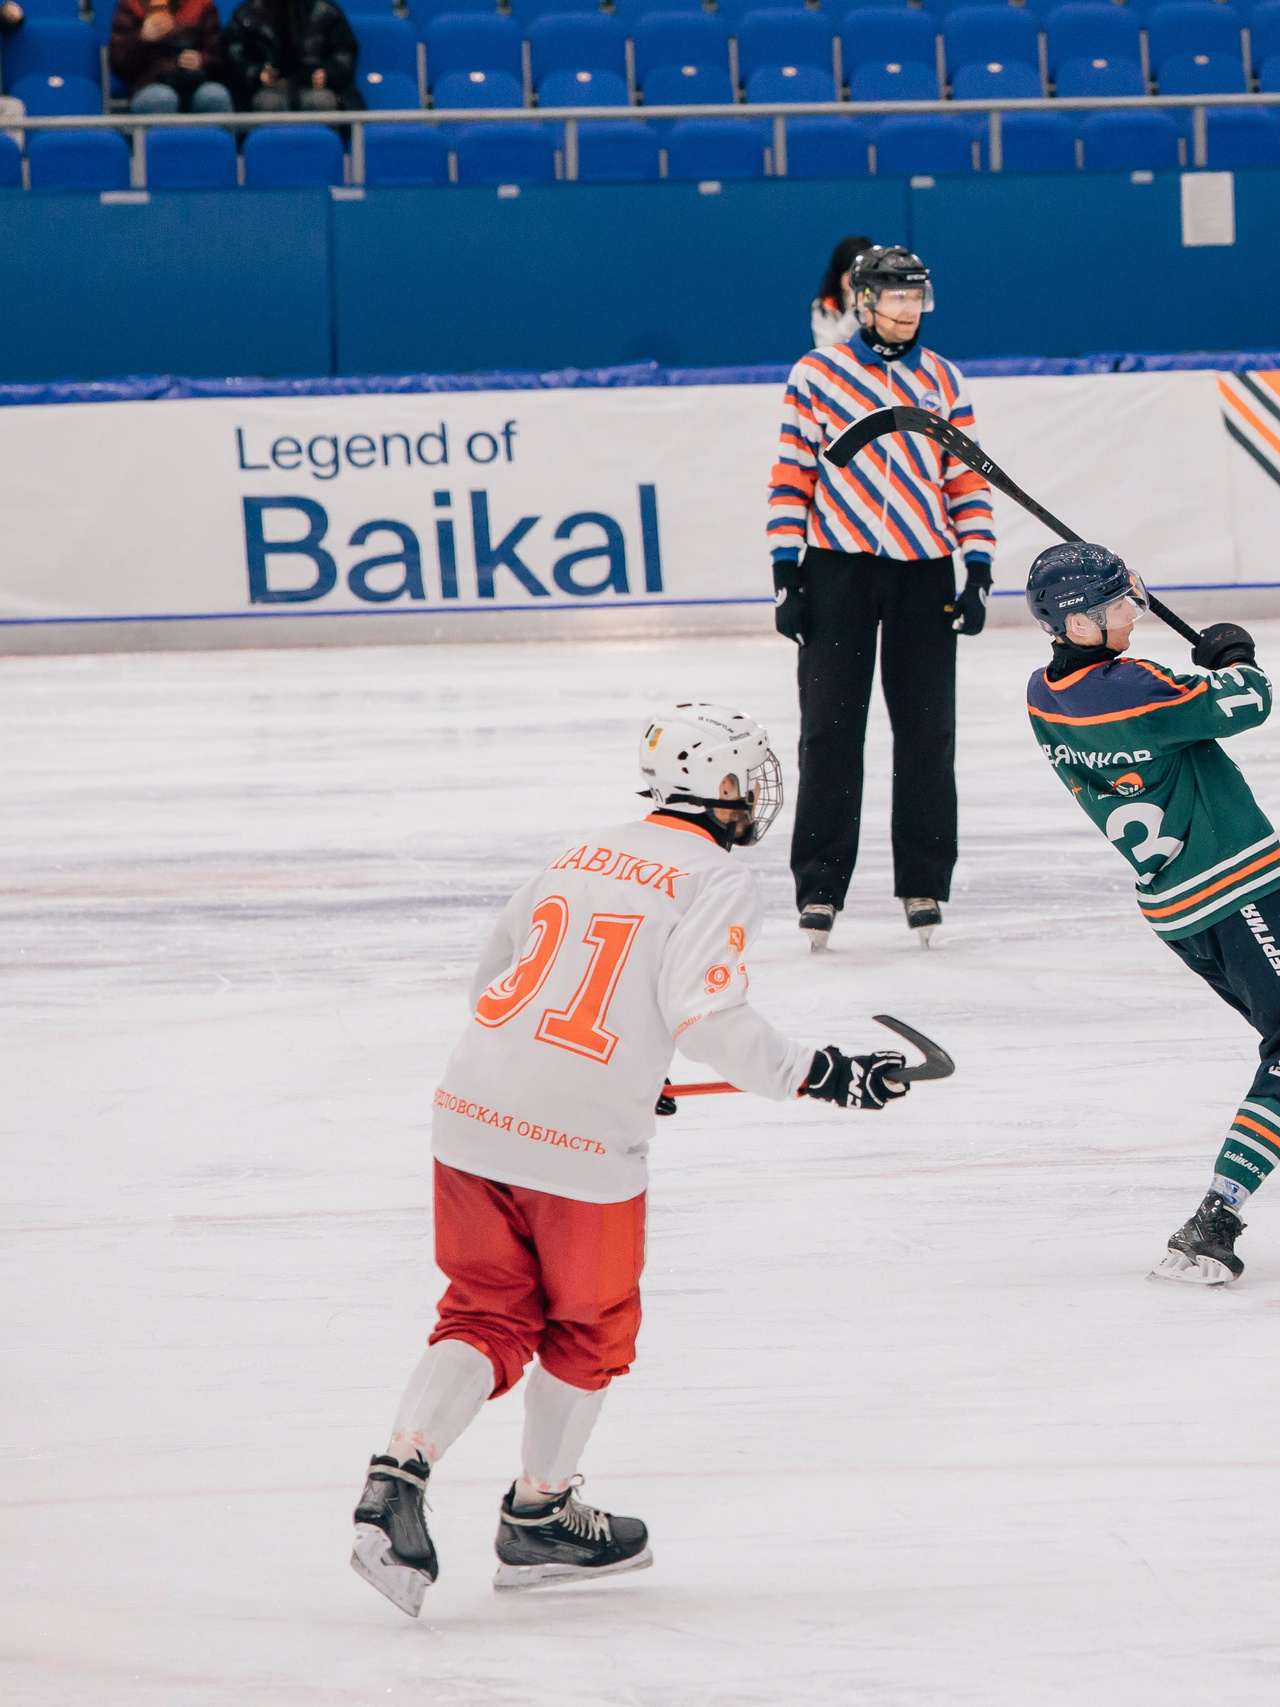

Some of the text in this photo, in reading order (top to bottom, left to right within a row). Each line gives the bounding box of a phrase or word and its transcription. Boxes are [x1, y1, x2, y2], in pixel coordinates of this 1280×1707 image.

[236, 419, 517, 480] Legend of
[243, 484, 664, 604] Baikal
[1059, 596, 1084, 608] CCM
[516, 1121, 606, 1155] ОБЛАСТЬ
